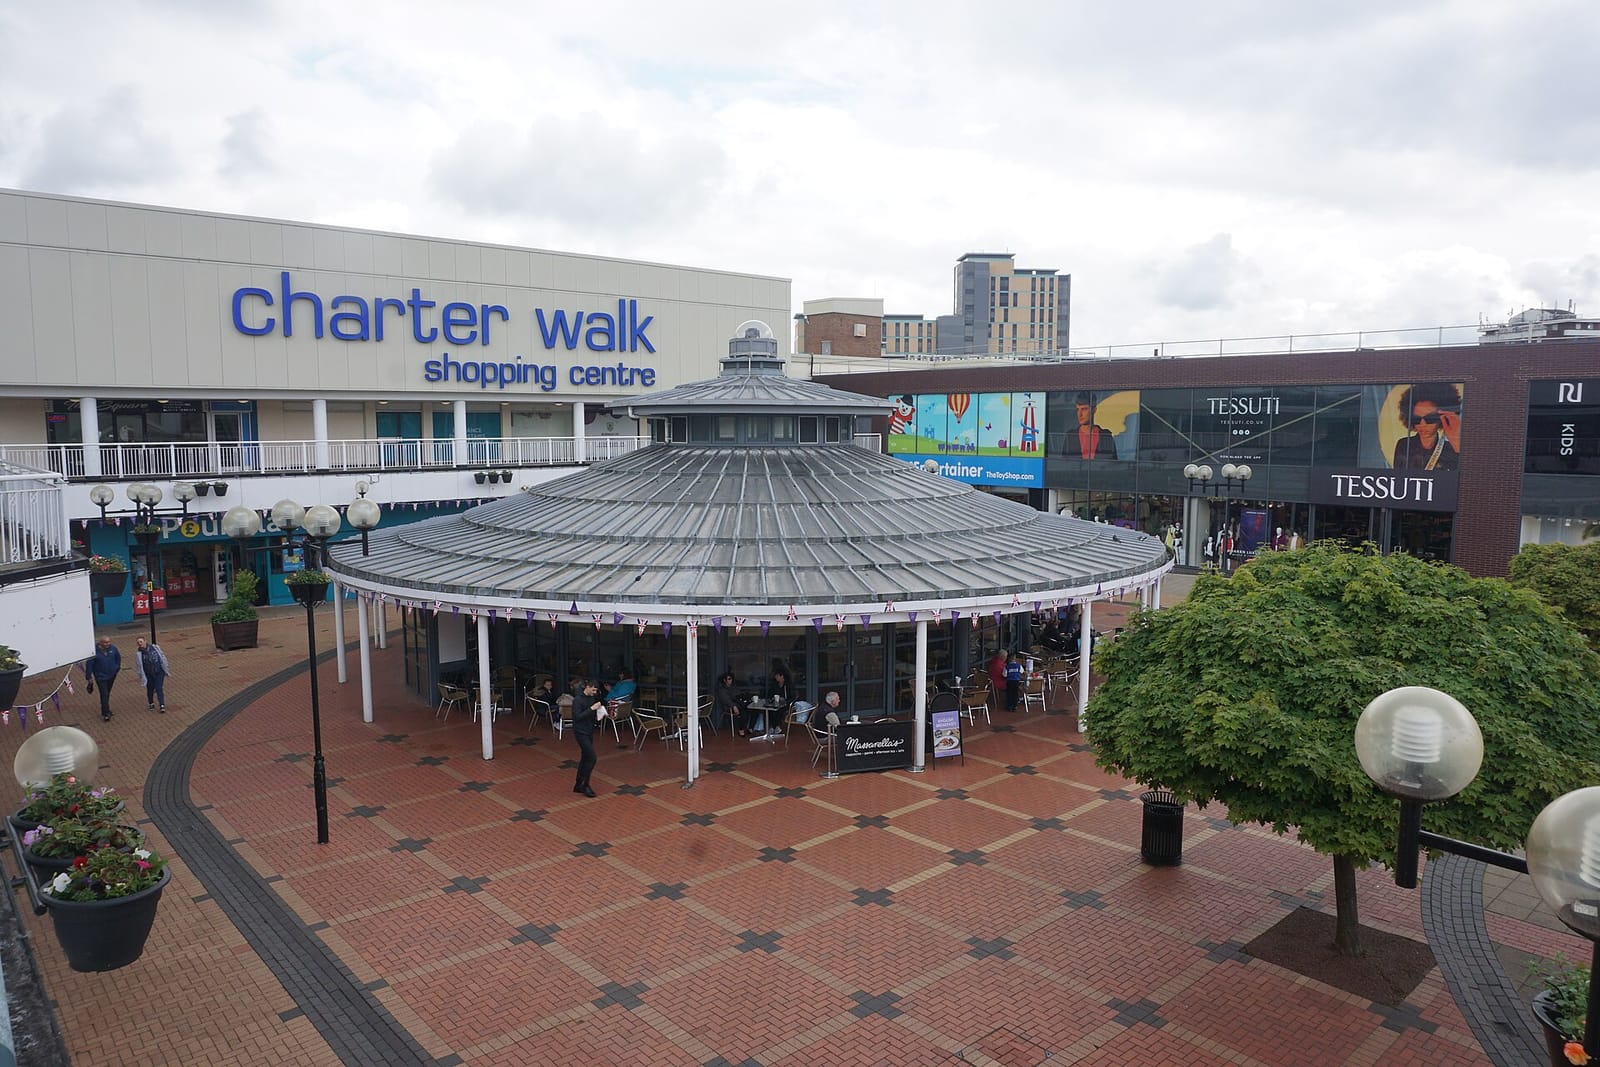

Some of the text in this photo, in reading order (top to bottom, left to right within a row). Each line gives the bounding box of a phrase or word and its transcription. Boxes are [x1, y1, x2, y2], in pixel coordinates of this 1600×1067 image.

[232, 271, 657, 354] charter walk
[424, 353, 656, 392] shopping centre
[1207, 397, 1280, 414] TESSUTI
[1560, 423, 1576, 456] KIDS
[986, 471, 1035, 481] TheToyShop.com
[1331, 474, 1435, 502] TESSUTI
[137, 599, 150, 609] £1
